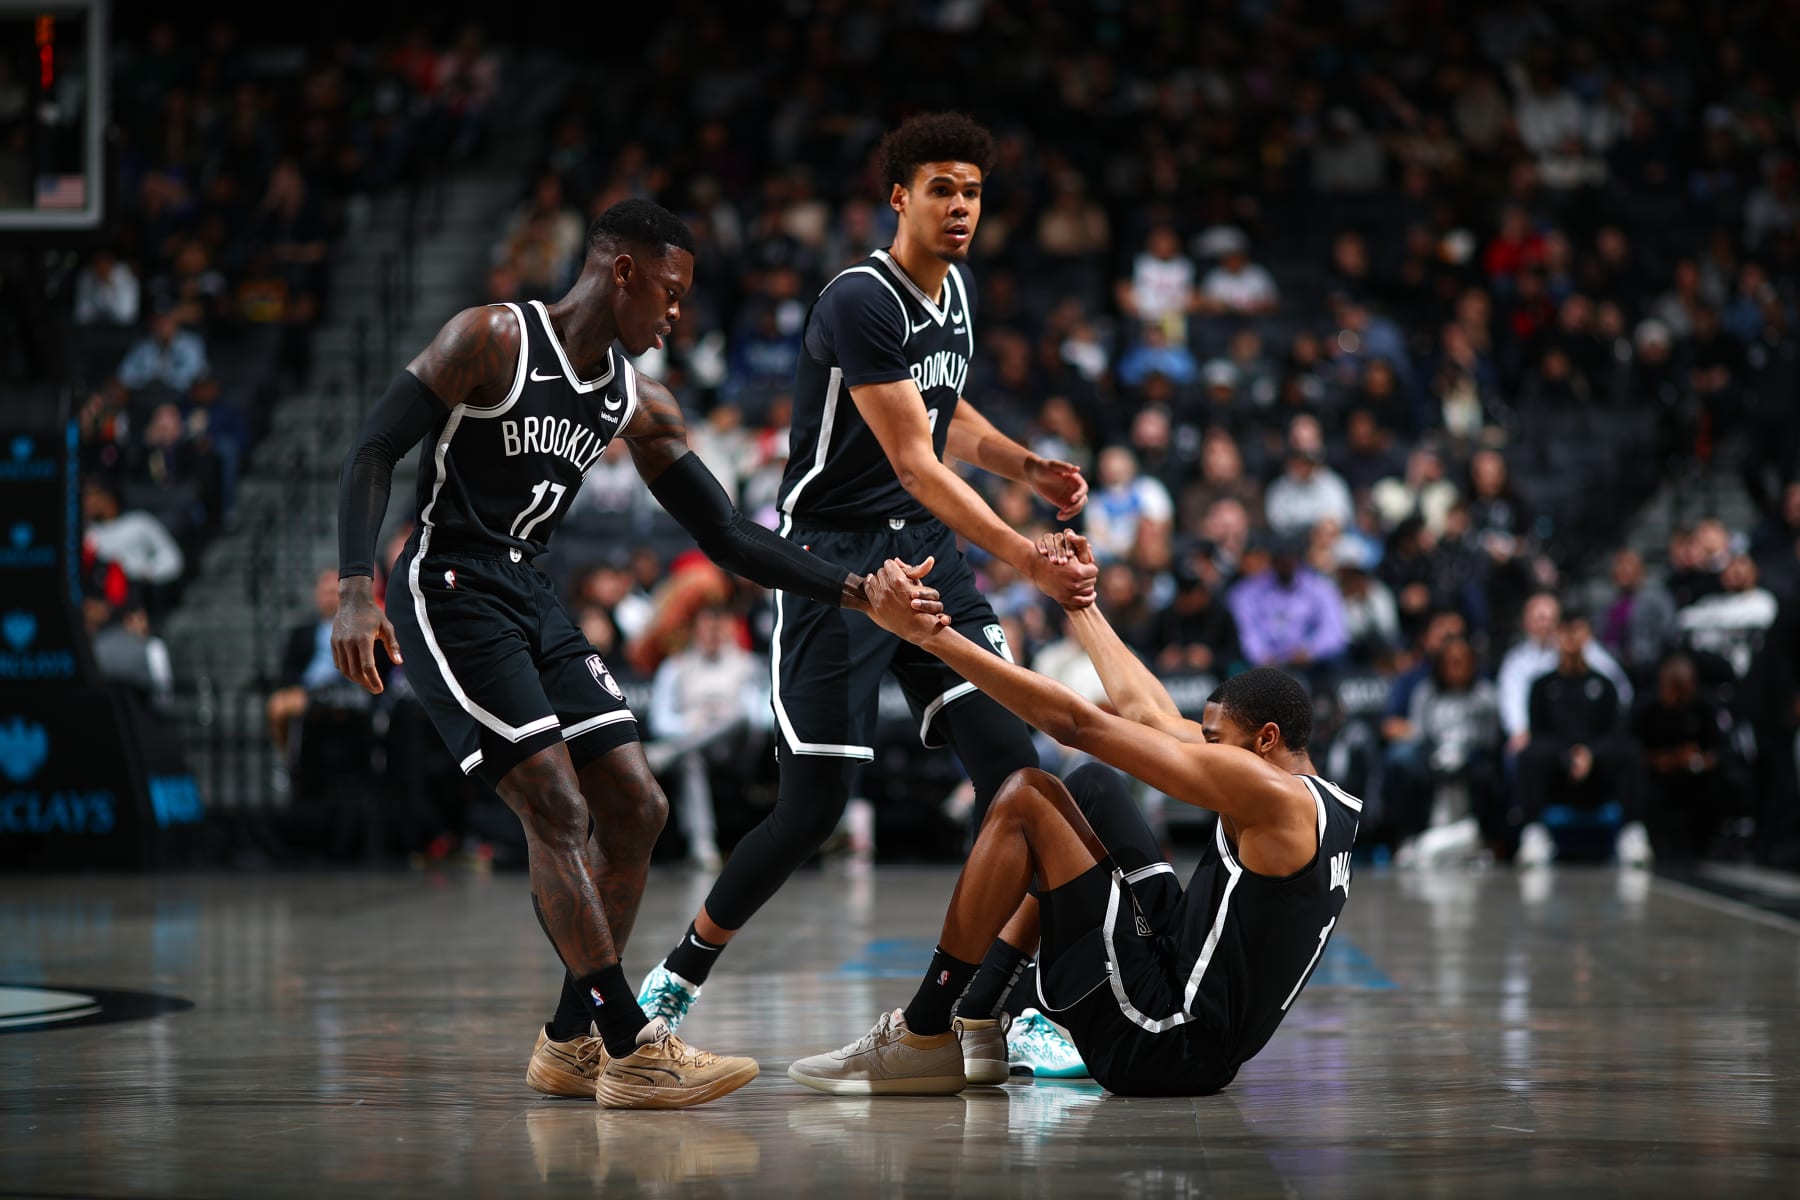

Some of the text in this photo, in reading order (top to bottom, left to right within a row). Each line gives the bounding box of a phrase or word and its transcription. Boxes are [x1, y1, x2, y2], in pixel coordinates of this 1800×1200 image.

[910, 350, 968, 399] ROOKLY
[502, 416, 607, 481] BROOKLY
[509, 479, 567, 540] 17
[0, 787, 115, 834] CLAYS
